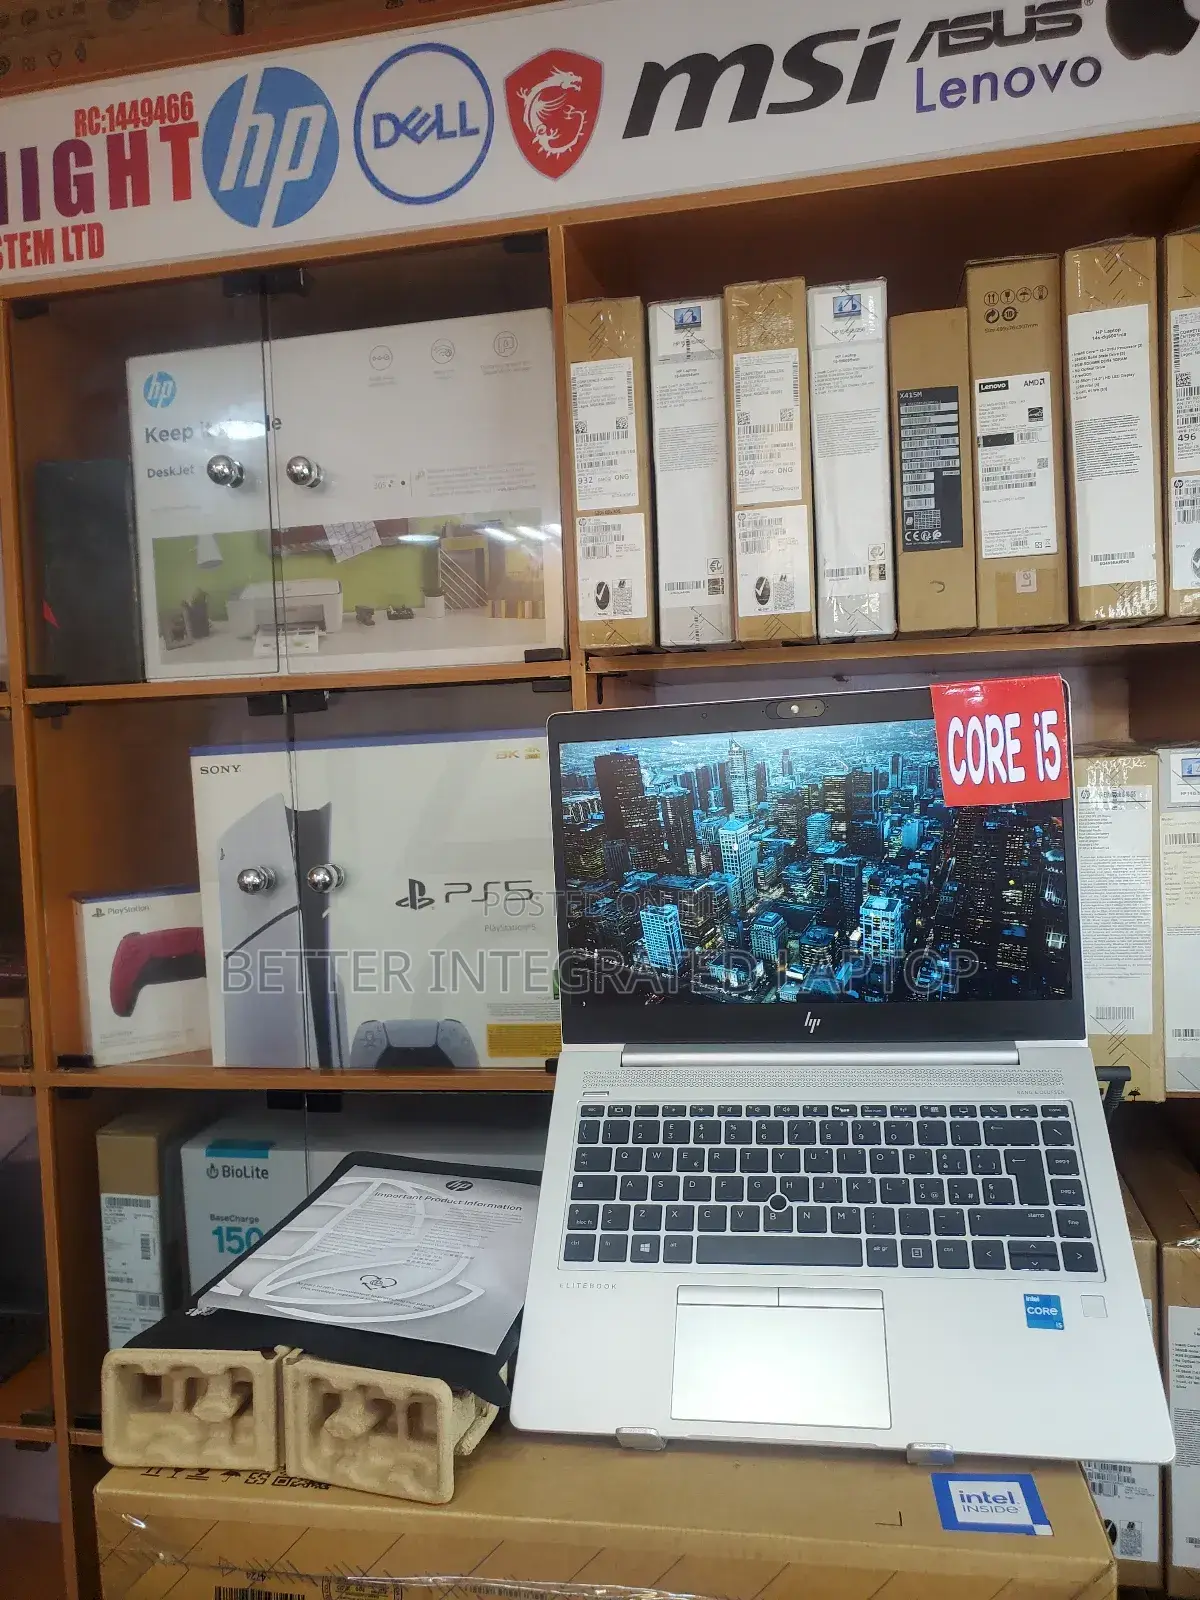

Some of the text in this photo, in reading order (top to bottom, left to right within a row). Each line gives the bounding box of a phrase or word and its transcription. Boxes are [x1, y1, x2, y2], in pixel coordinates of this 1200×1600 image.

[906, 0, 1083, 63] ASUS
[622, 19, 901, 139] msi
[915, 56, 1102, 114] Lenovo
[74, 91, 194, 138] RC:1449466
[373, 100, 480, 150] DELL
[208, 67, 335, 228] hp
[61, 222, 105, 263] LTD
[143, 371, 177, 408] hp
[979, 379, 1039, 392] Lenovo AMD
[144, 425, 195, 444] Keep
[1177, 433, 1197, 441] 496
[147, 465, 196, 479] DeskJet
[738, 468, 756, 477] 494
[577, 476, 594, 484] 932
[947, 709, 1062, 786] CORE i5
[199, 764, 241, 775] SONY
[443, 879, 535, 904] PS5
[107, 905, 151, 915] PlayStation
[620, 1151, 629, 1160] Q
[652, 1151, 662, 1159] W
[682, 1151, 689, 1159] E
[713, 1152, 720, 1160] R
[745, 1152, 751, 1160] T
[778, 1152, 785, 1160] Y
[222, 1165, 269, 1180] BioLite
[626, 1180, 634, 1188] A
[657, 1180, 664, 1188] S
[689, 1180, 696, 1188] D
[720, 1180, 727, 1188] F
[754, 1180, 761, 1188] G
[786, 1181, 793, 1189] H
[374, 1191, 523, 1212] Important Product Information
[639, 1209, 646, 1217] Z
[671, 1210, 678, 1218] X
[703, 1210, 711, 1218] C
[736, 1210, 744, 1218] V
[769, 1212, 777, 1220] B
[803, 1211, 811, 1219] N
[837, 1212, 846, 1220] M
[209, 1213, 260, 1224] BaseCharge
[559, 1282, 617, 1290] ELITEBOOK
[958, 1490, 1016, 1505] intel
